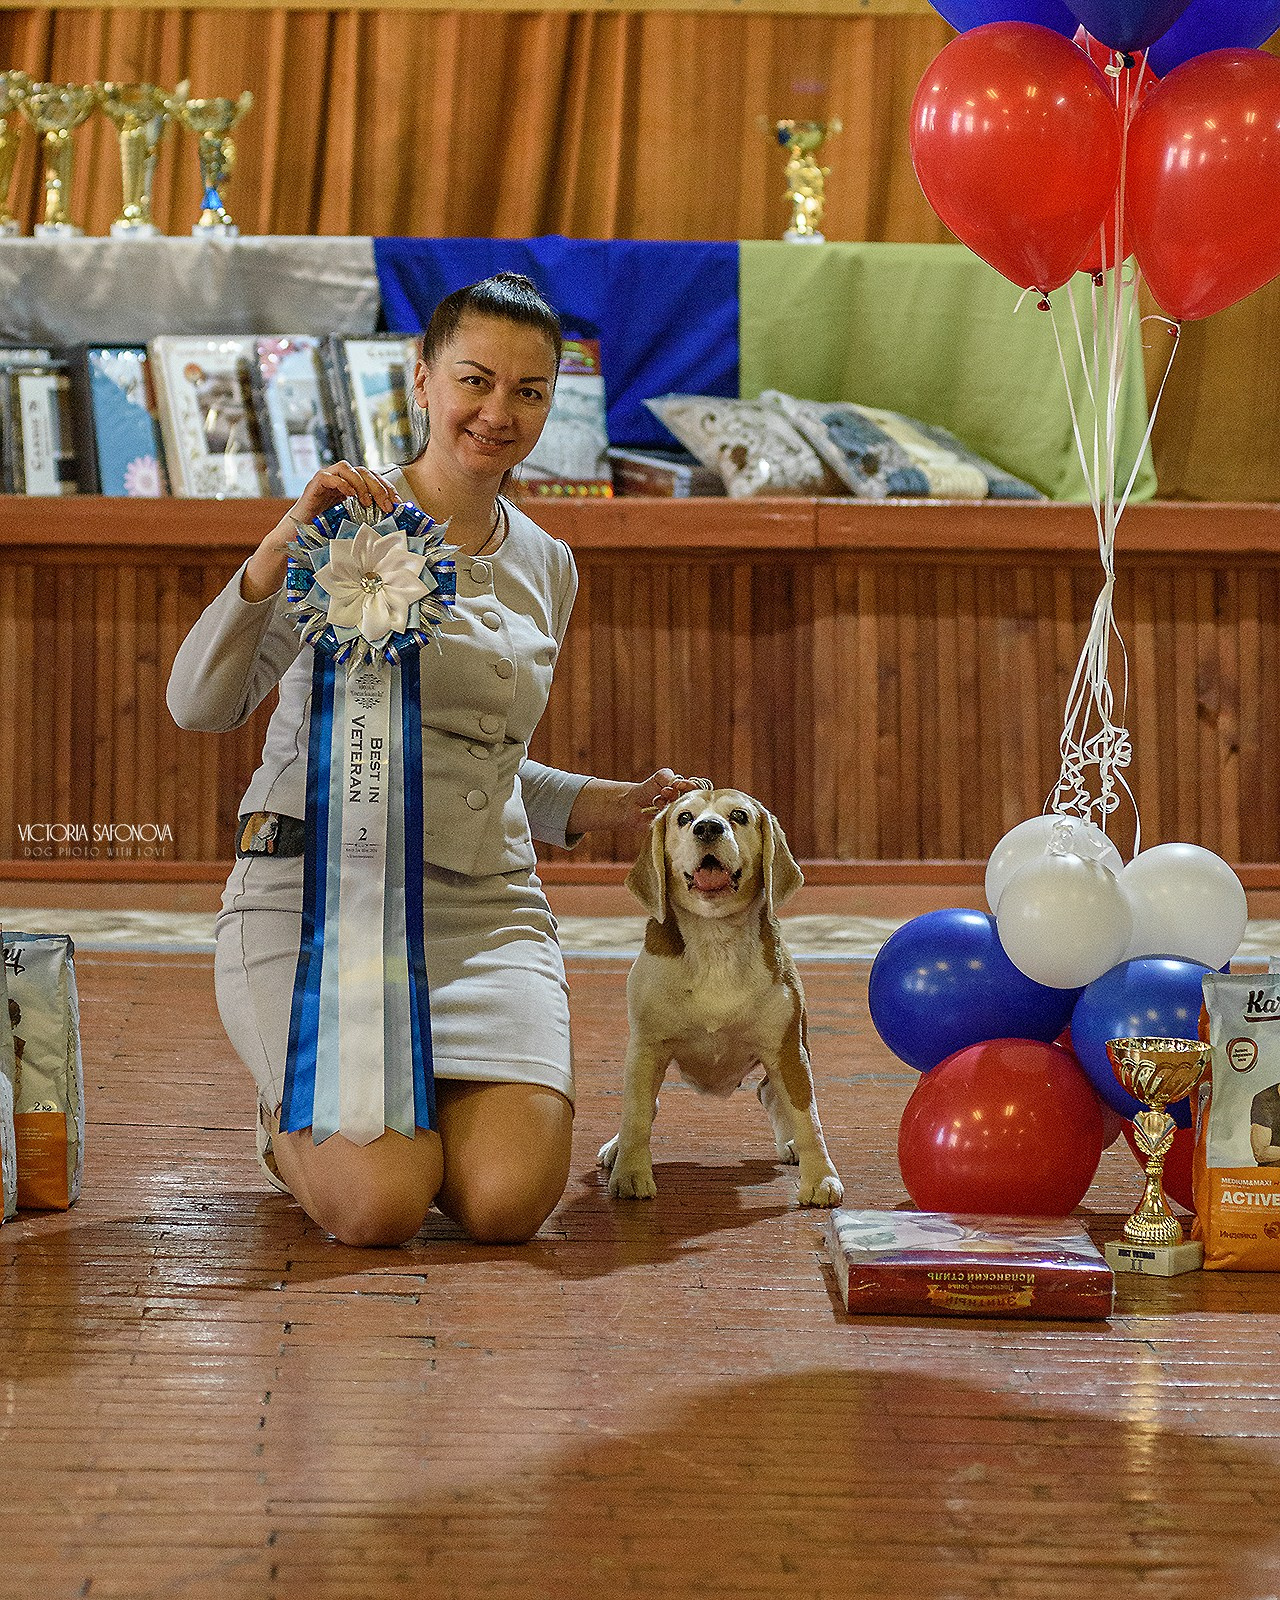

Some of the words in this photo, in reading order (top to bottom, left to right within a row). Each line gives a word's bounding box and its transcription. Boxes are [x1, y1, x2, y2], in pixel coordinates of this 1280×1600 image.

[349, 714, 366, 803] VETERAN
[369, 736, 383, 781] BEST
[368, 786, 380, 803] IN
[358, 827, 368, 841] 2
[34, 1101, 41, 1111] 2
[1221, 1176, 1272, 1186] MEDIUM&MAXI
[1221, 1190, 1280, 1207] ACTIVE
[927, 1272, 965, 1281] стиль
[967, 1272, 1035, 1283] Испанский
